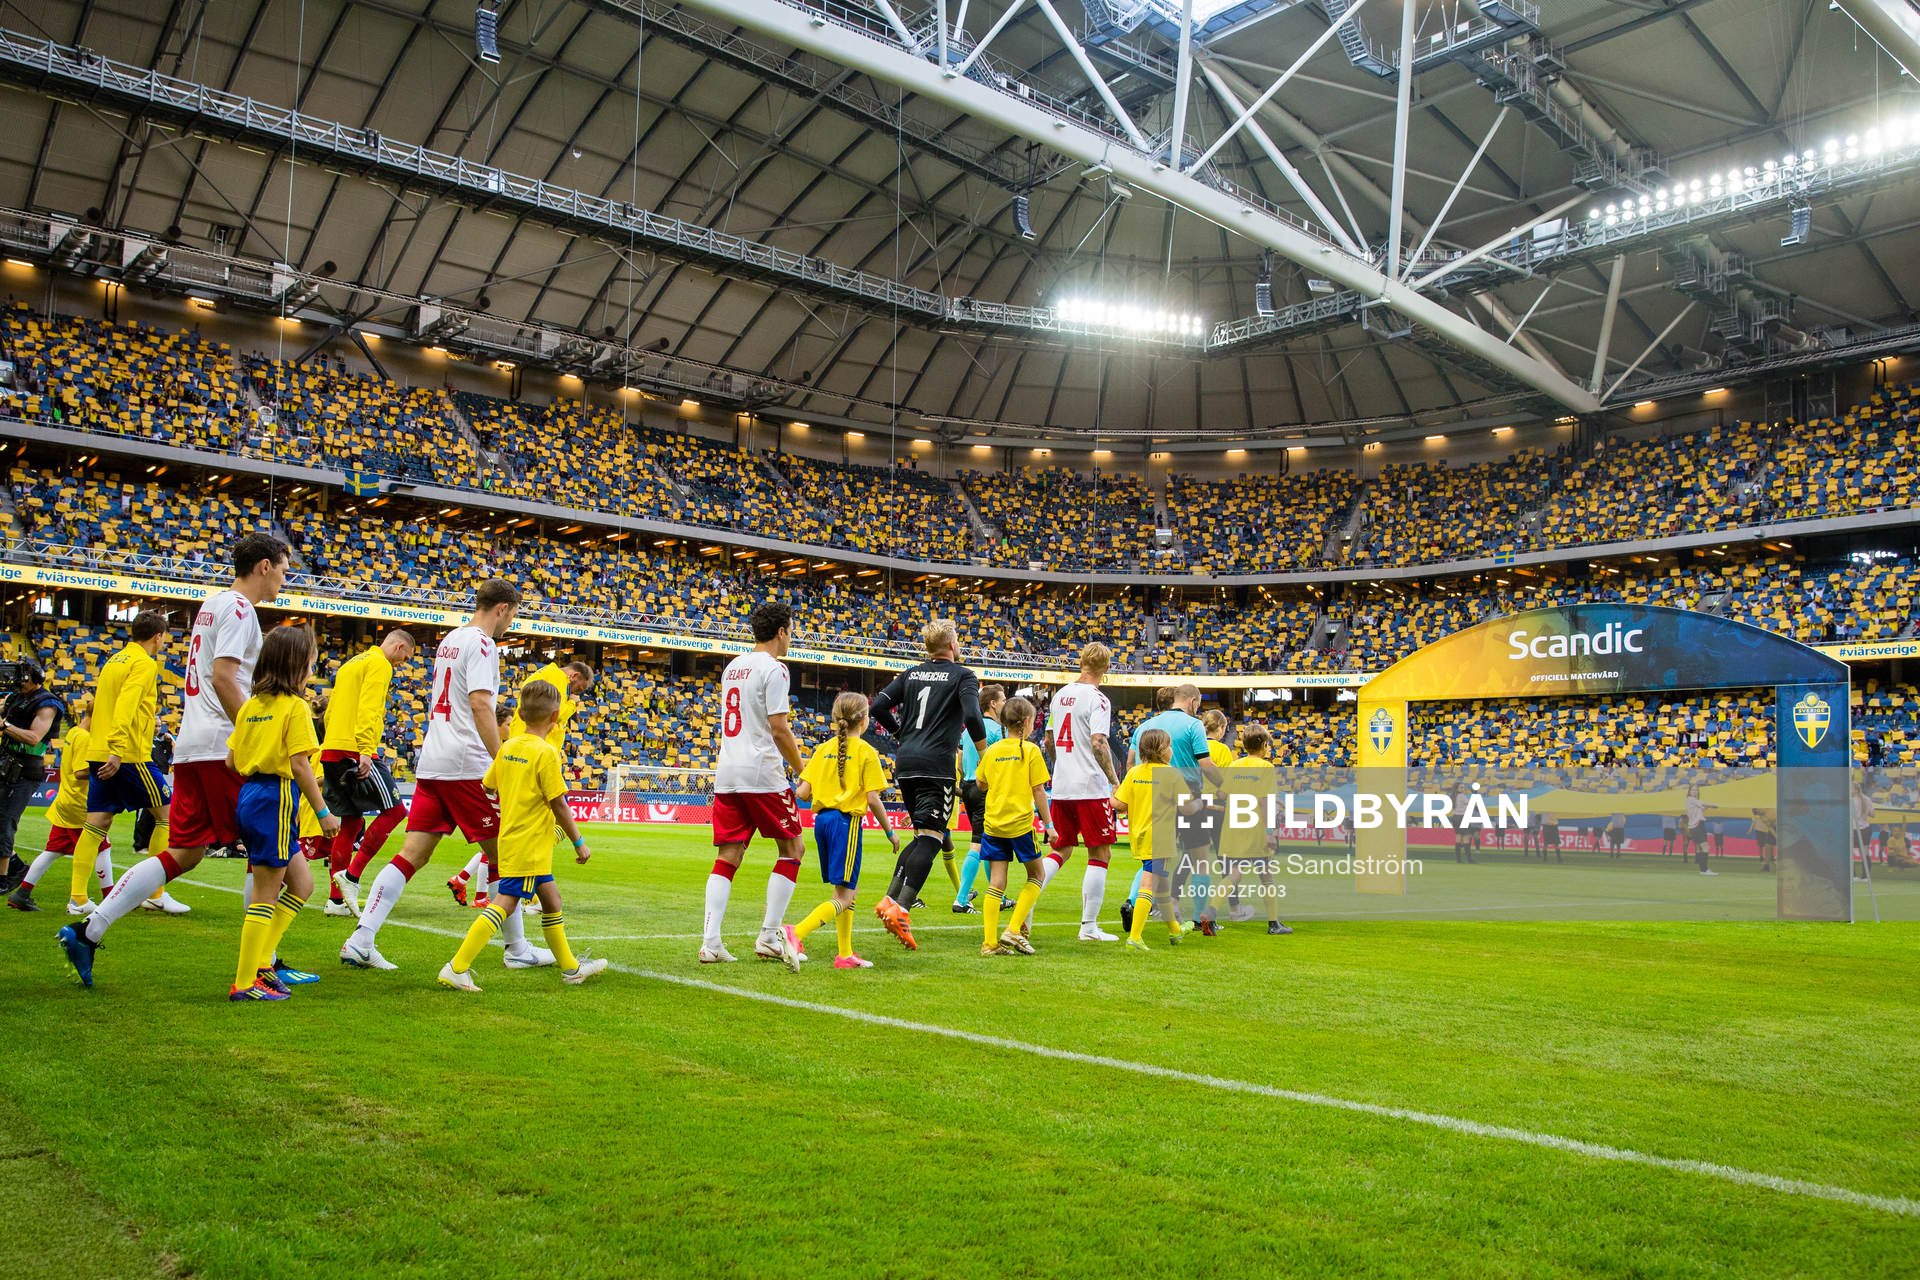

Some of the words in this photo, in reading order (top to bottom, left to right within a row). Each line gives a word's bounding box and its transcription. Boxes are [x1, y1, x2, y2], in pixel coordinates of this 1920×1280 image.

[36, 569, 118, 589] #viärsverige
[131, 579, 207, 598] #viärsverige
[302, 598, 370, 615] #viärsverige
[381, 607, 445, 622] #viärsverige
[531, 623, 589, 637] #viärsverige
[598, 630, 653, 644] #viärsverige
[661, 636, 713, 650] #viärsverige
[832, 654, 878, 667] #viärsverige
[983, 669, 1034, 680] #viärsverige
[1508, 622, 1643, 660] Scandic
[1839, 644, 1917, 656] #viärsverige
[908, 671, 949, 682] SCHMEICHEL
[1530, 674, 1569, 682] OFFICIELL
[1570, 671, 1619, 681] MATCHVÅRD
[724, 687, 742, 737] 8
[916, 686, 931, 729] 1
[1056, 712, 1074, 753] 4
